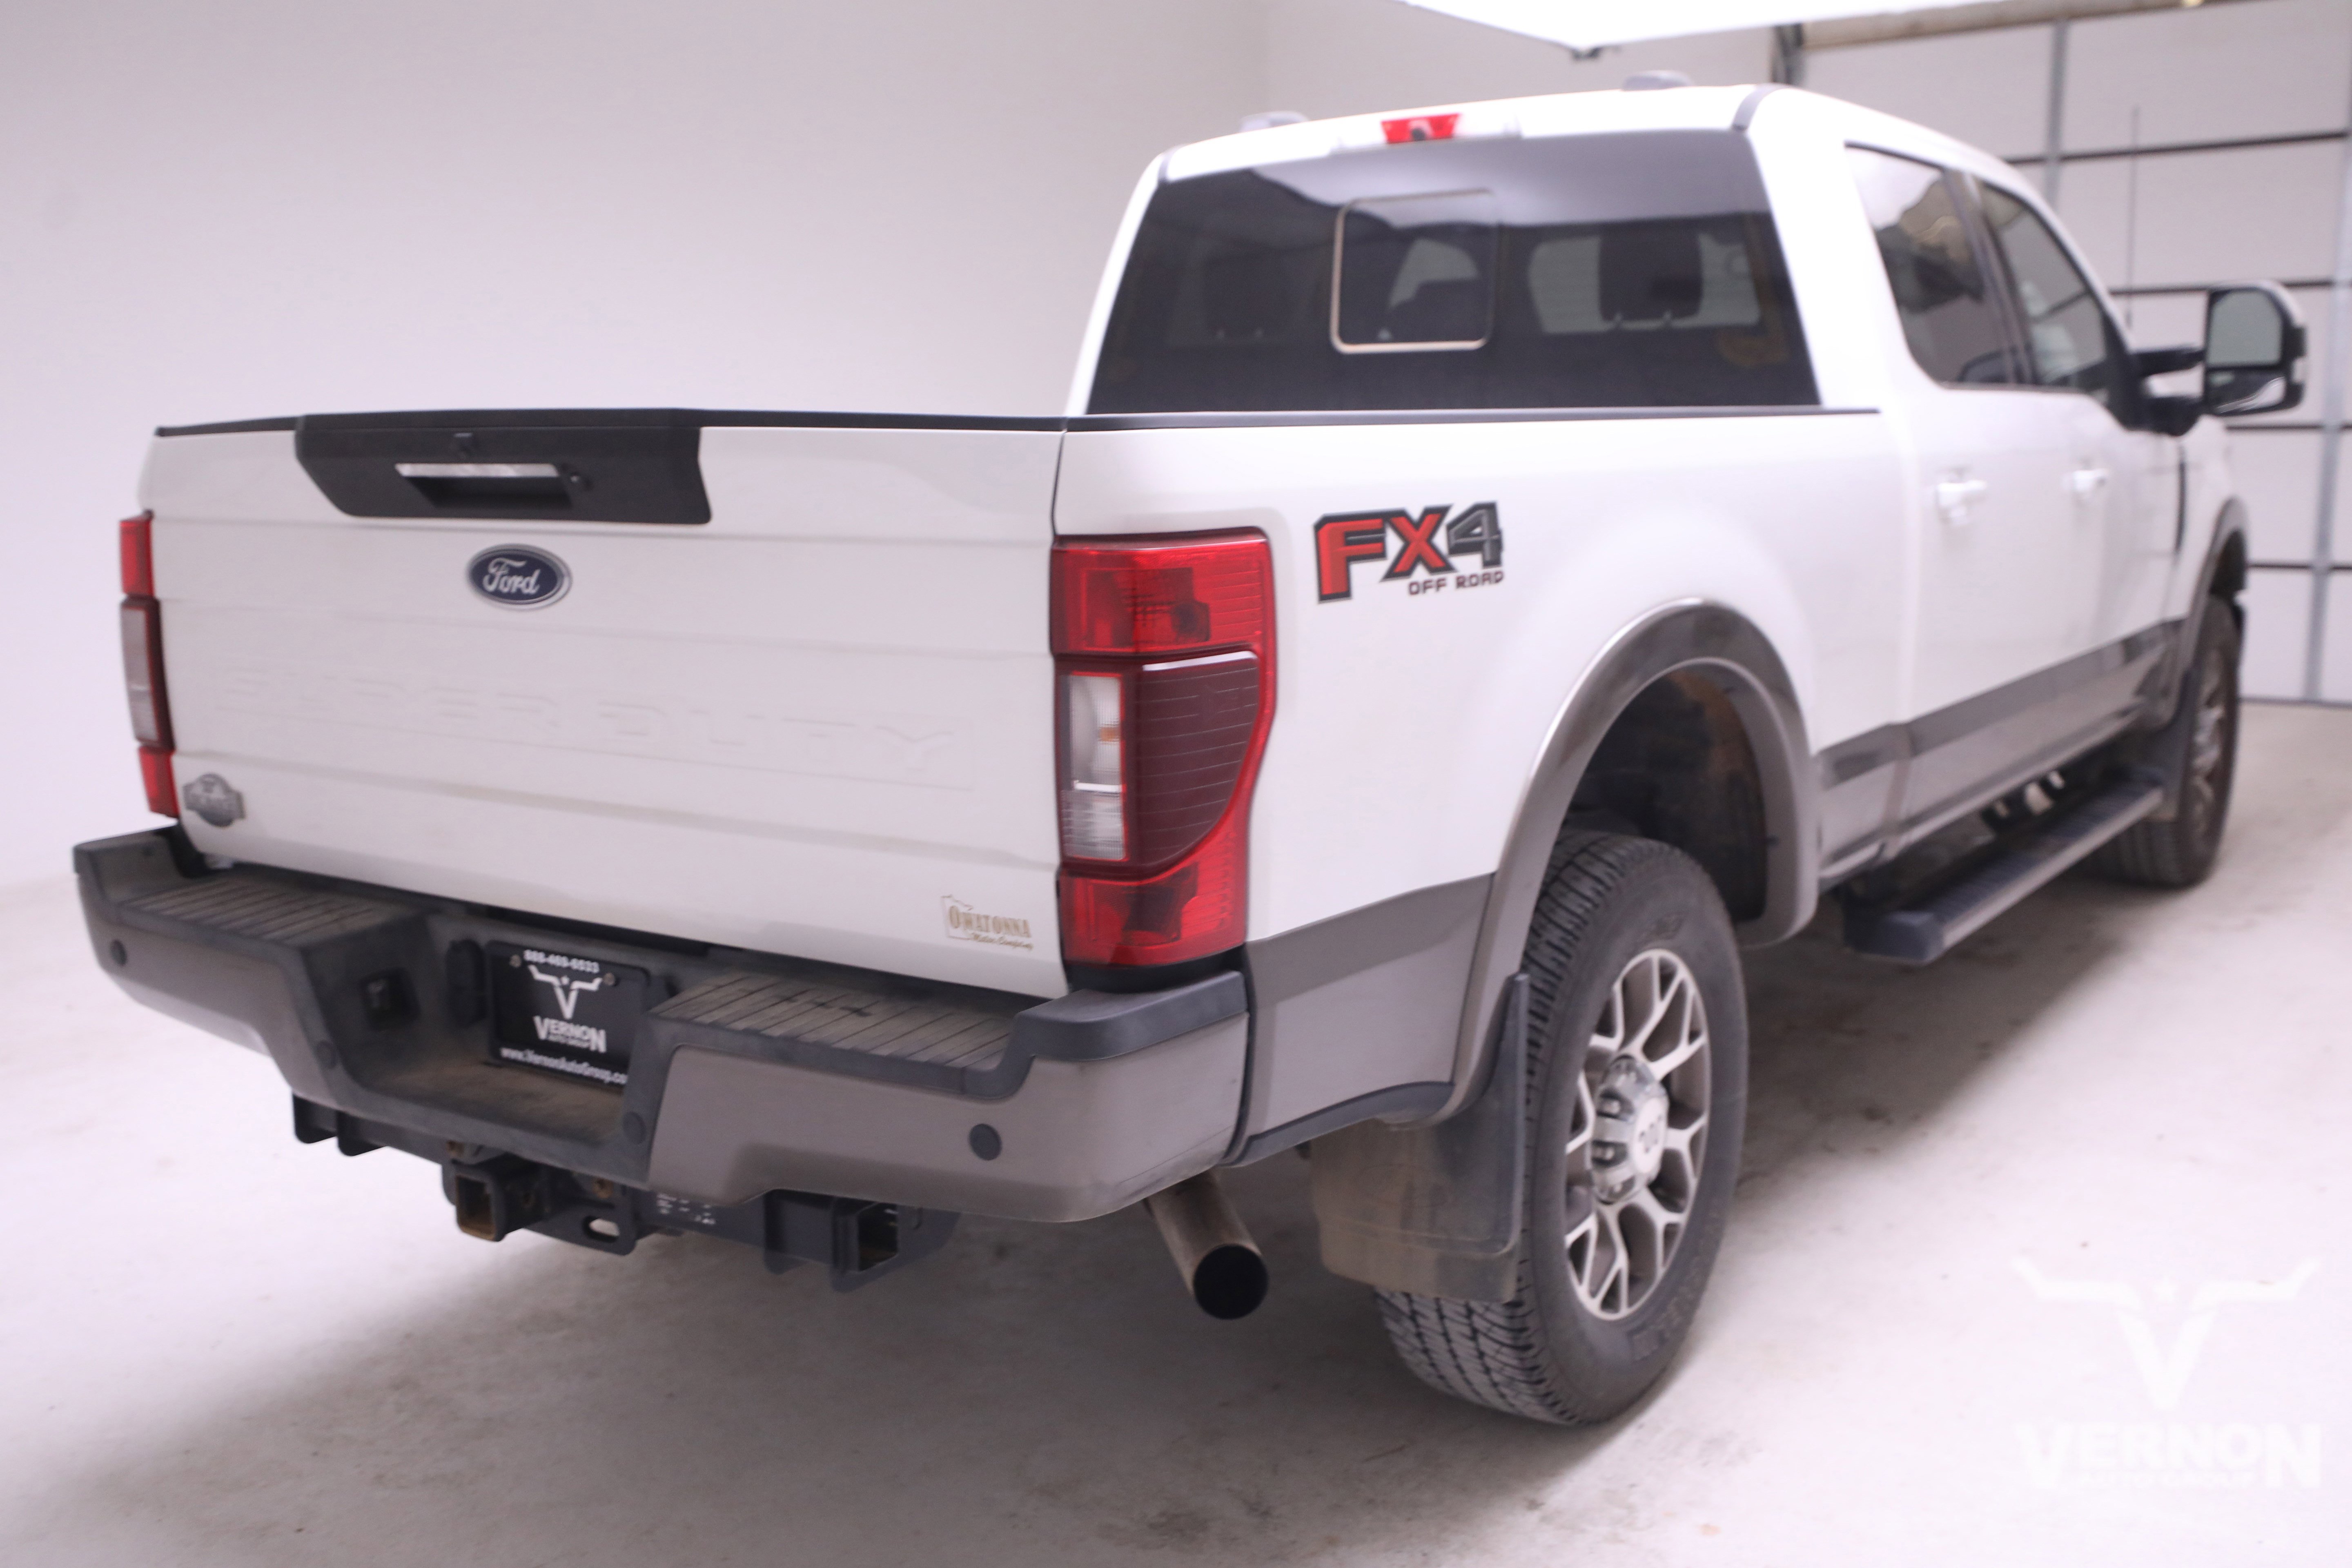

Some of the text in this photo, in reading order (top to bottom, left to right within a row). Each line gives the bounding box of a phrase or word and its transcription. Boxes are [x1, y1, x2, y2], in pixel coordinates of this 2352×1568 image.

[1313, 501, 1503, 604] FX4
[483, 557, 541, 594] Ford
[1408, 571, 1504, 595] OFF ROAD
[534, 1016, 607, 1054] VERNON
[500, 1047, 628, 1085] www.VernonAutoGroup.co
